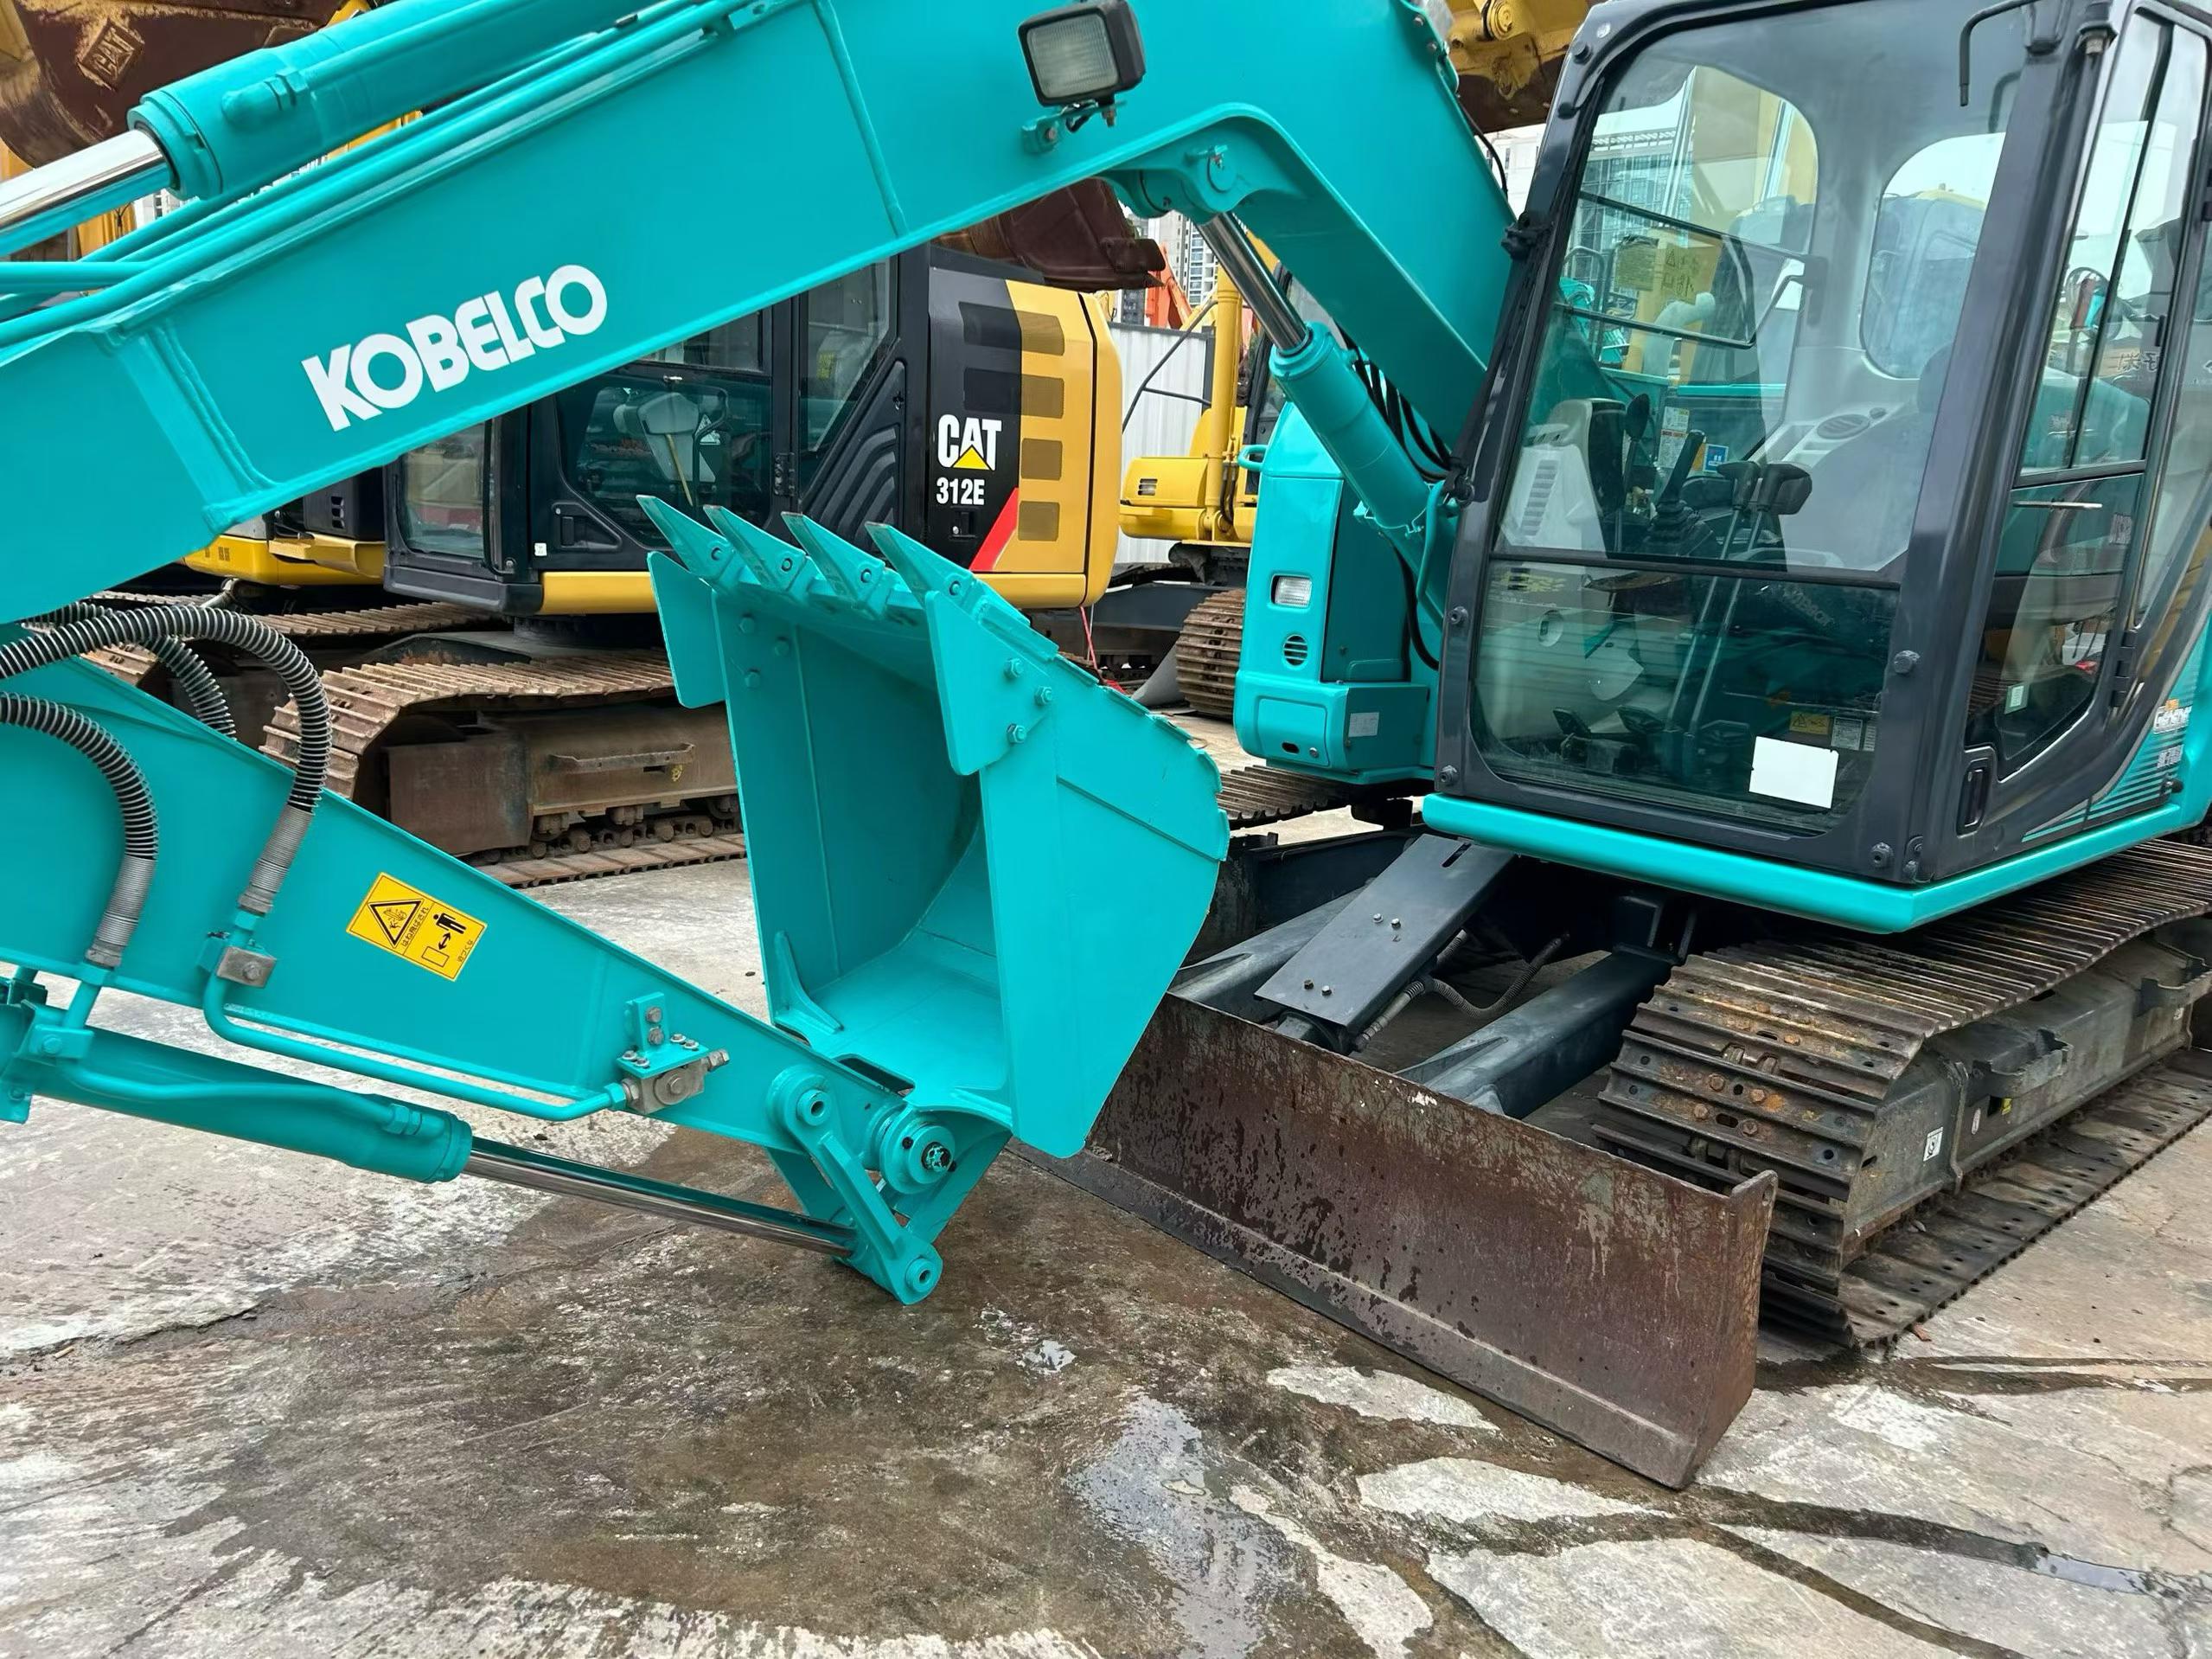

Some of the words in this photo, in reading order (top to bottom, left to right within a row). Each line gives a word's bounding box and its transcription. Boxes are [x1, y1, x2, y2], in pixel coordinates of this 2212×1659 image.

[301, 264, 607, 432] KOBELCO
[937, 414, 1002, 471] CAT
[936, 477, 985, 505] 312E
[400, 906, 430, 947] はね飛ばされ
